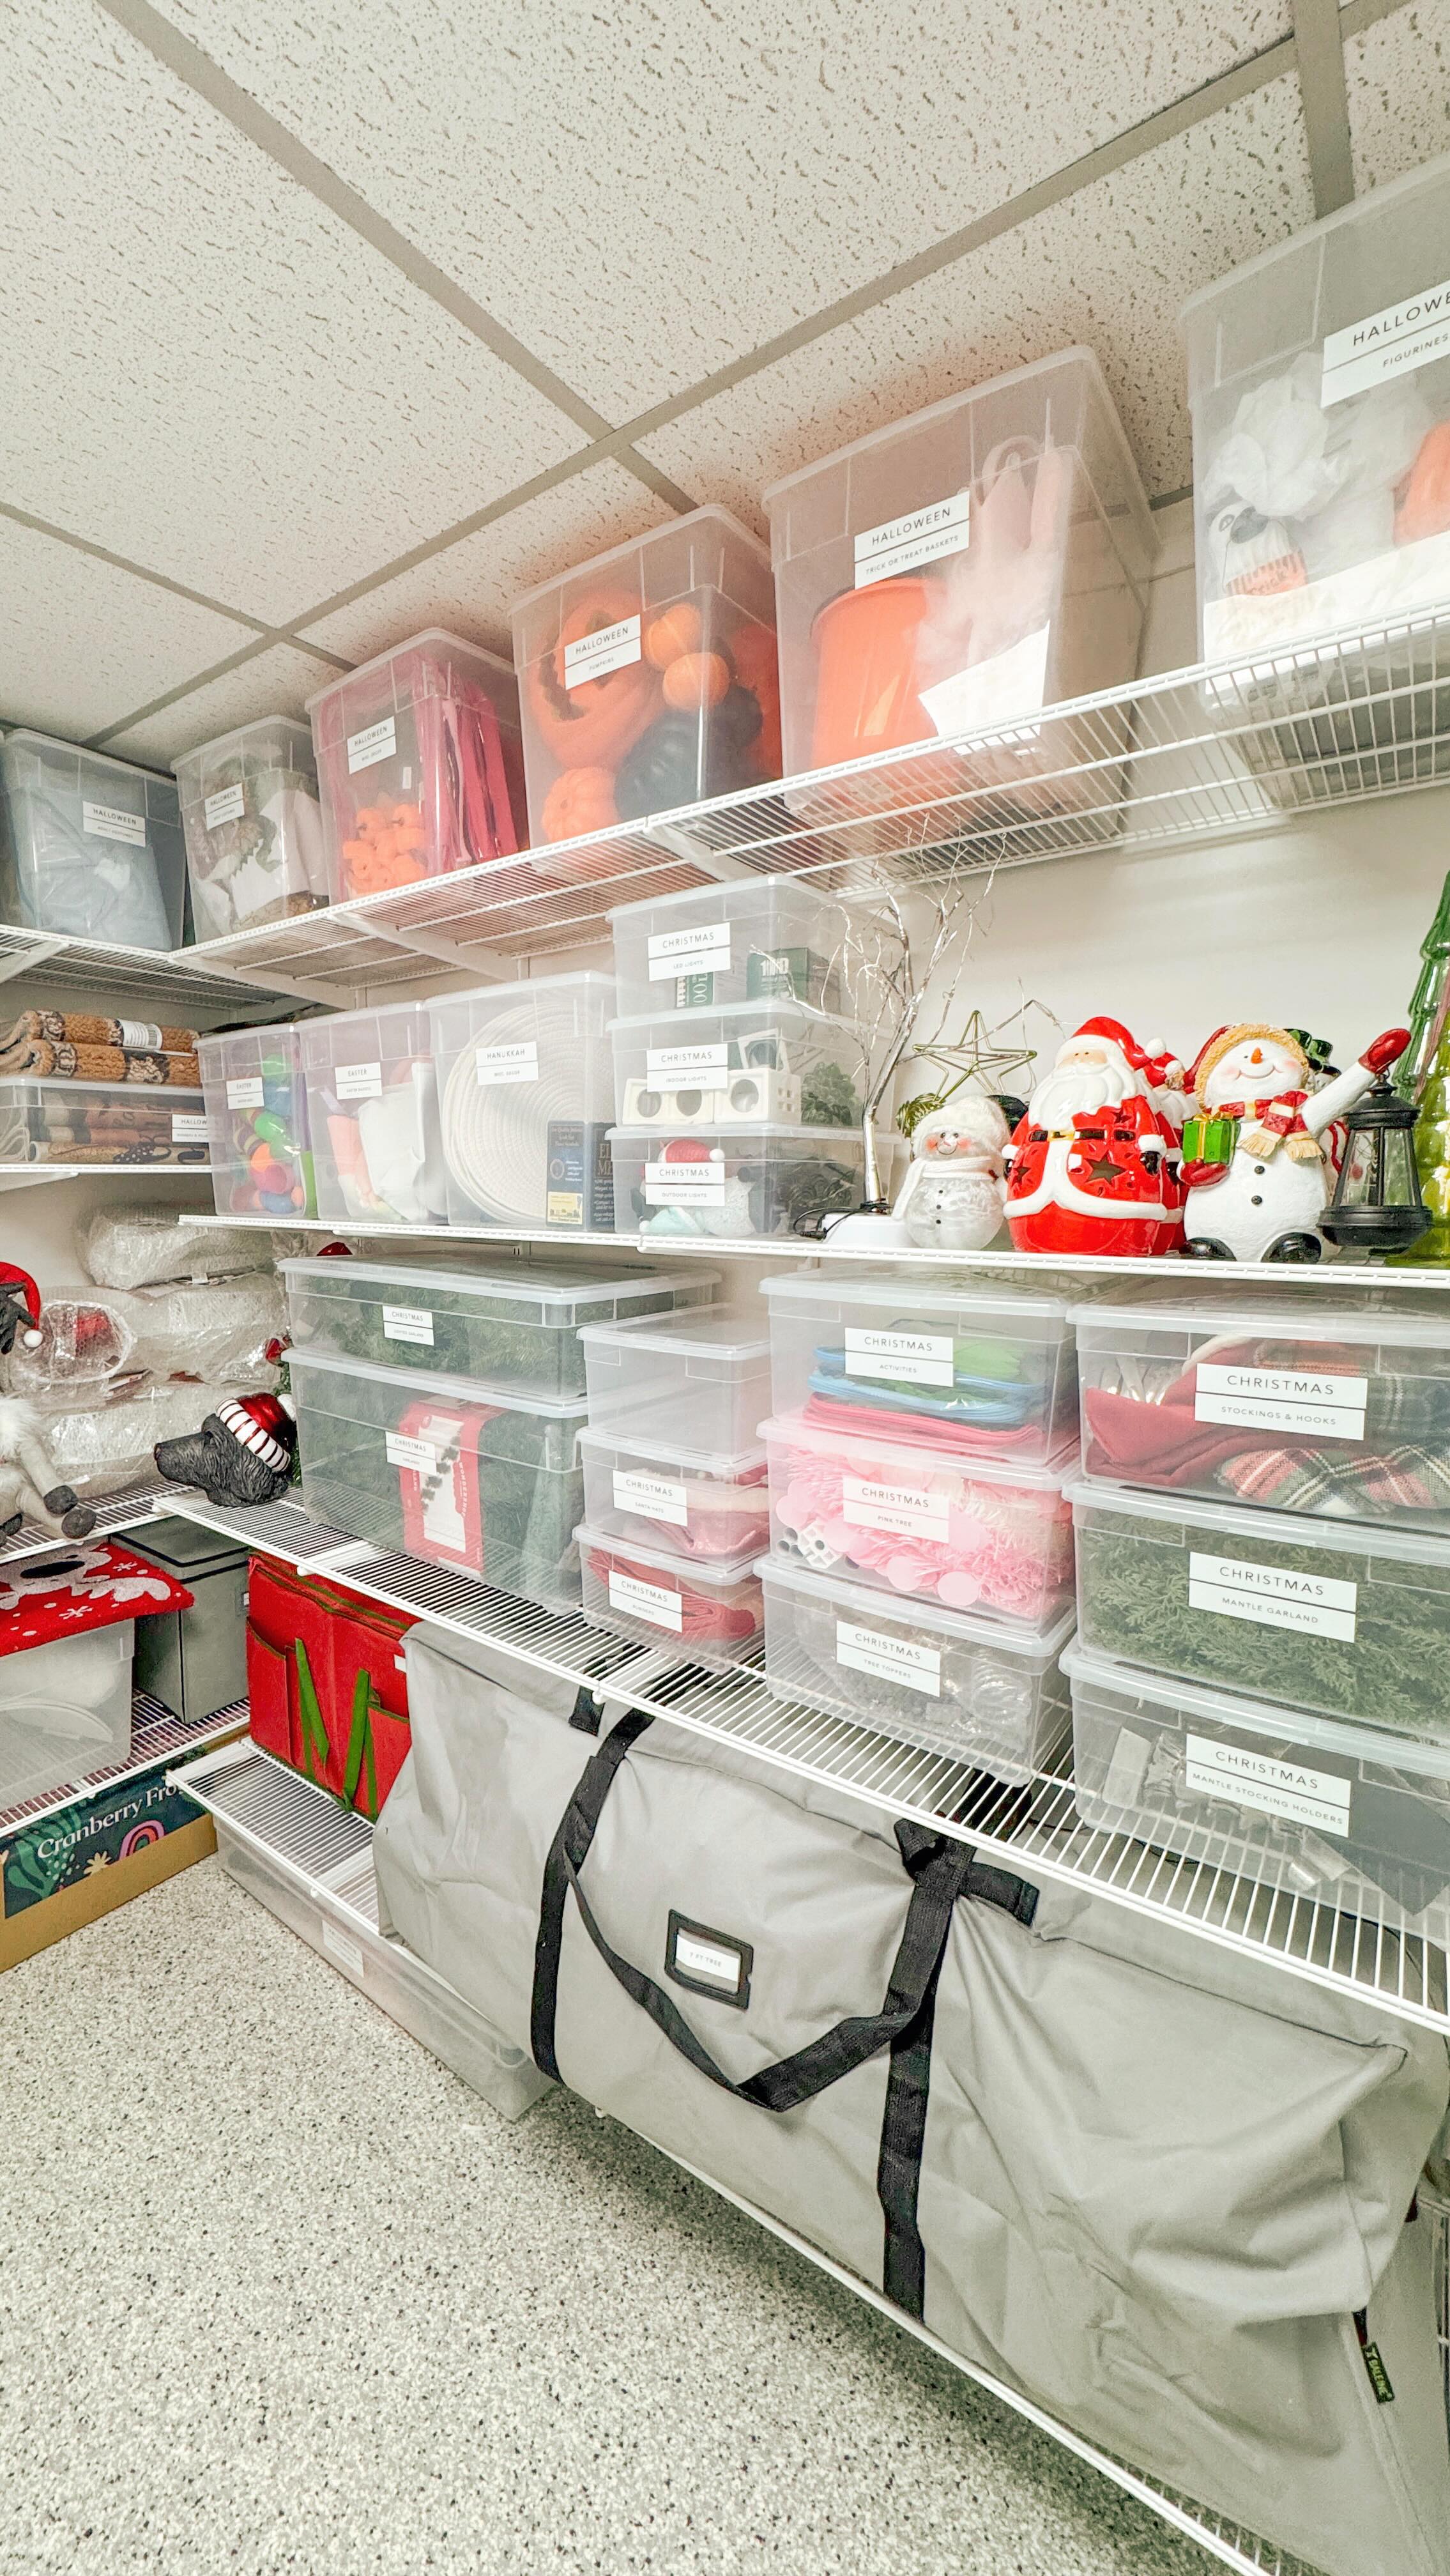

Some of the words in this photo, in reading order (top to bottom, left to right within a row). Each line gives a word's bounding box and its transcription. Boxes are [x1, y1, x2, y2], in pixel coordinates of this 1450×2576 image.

[1383, 333, 1448, 367] FIGURINES
[872, 507, 950, 544] HALLOWEEN
[866, 562, 885, 574] TRICK
[888, 558, 898, 566] OR
[900, 548, 922, 560] TREAT
[925, 535, 958, 552] BASKETS
[576, 627, 628, 654] HALLOWEEN
[354, 725, 387, 746] HALLOWEEN
[210, 790, 236, 806] HALLOWEEN
[93, 808, 136, 825] HALLOWEEN
[662, 931, 714, 948] CHRISTMAS
[684, 959, 703, 967] LIGHTS
[487, 1048, 524, 1058] HANUKKAH
[660, 1051, 712, 1062] CHRISTMAS
[347, 1068, 367, 1077] EASTER
[391, 1311, 423, 1321] CHRISTMAS
[864, 1336, 932, 1351] CHRISTMAS
[879, 1364, 917, 1373] ACTIVITIES
[1227, 1375, 1333, 1395] CHRISTMAS
[1221, 1406, 1281, 1419] STOCKINGS
[1296, 1415, 1336, 1425] HOOKS
[394, 1438, 425, 1452] CHRISTMAS
[625, 1479, 673, 1496] CHRISTMAS
[861, 1487, 928, 1508] CHRISTMAS
[877, 1515, 893, 1523] PINK
[895, 1519, 912, 1527] TREE
[1219, 1567, 1323, 1595] CHRISTMAS
[621, 1580, 667, 1602] CHRISTMAS
[1222, 1597, 1262, 1611] MANTLE
[1267, 1607, 1318, 1623] GARLAND
[855, 1633, 920, 1660] CHRISTMAS
[864, 1659, 879, 1668] TREE
[881, 1664, 911, 1678] TOPPERS
[1216, 1751, 1317, 1788] CHRISTMAS
[1193, 1773, 1231, 1790] MANTLE
[1235, 1786, 1288, 1807] STOCKING
[1292, 1804, 1342, 1824] HOLDERS
[37, 1798, 142, 1858] Cranberry
[146, 1782, 183, 1807] Fro
[705, 1957, 721, 1967] TREE
